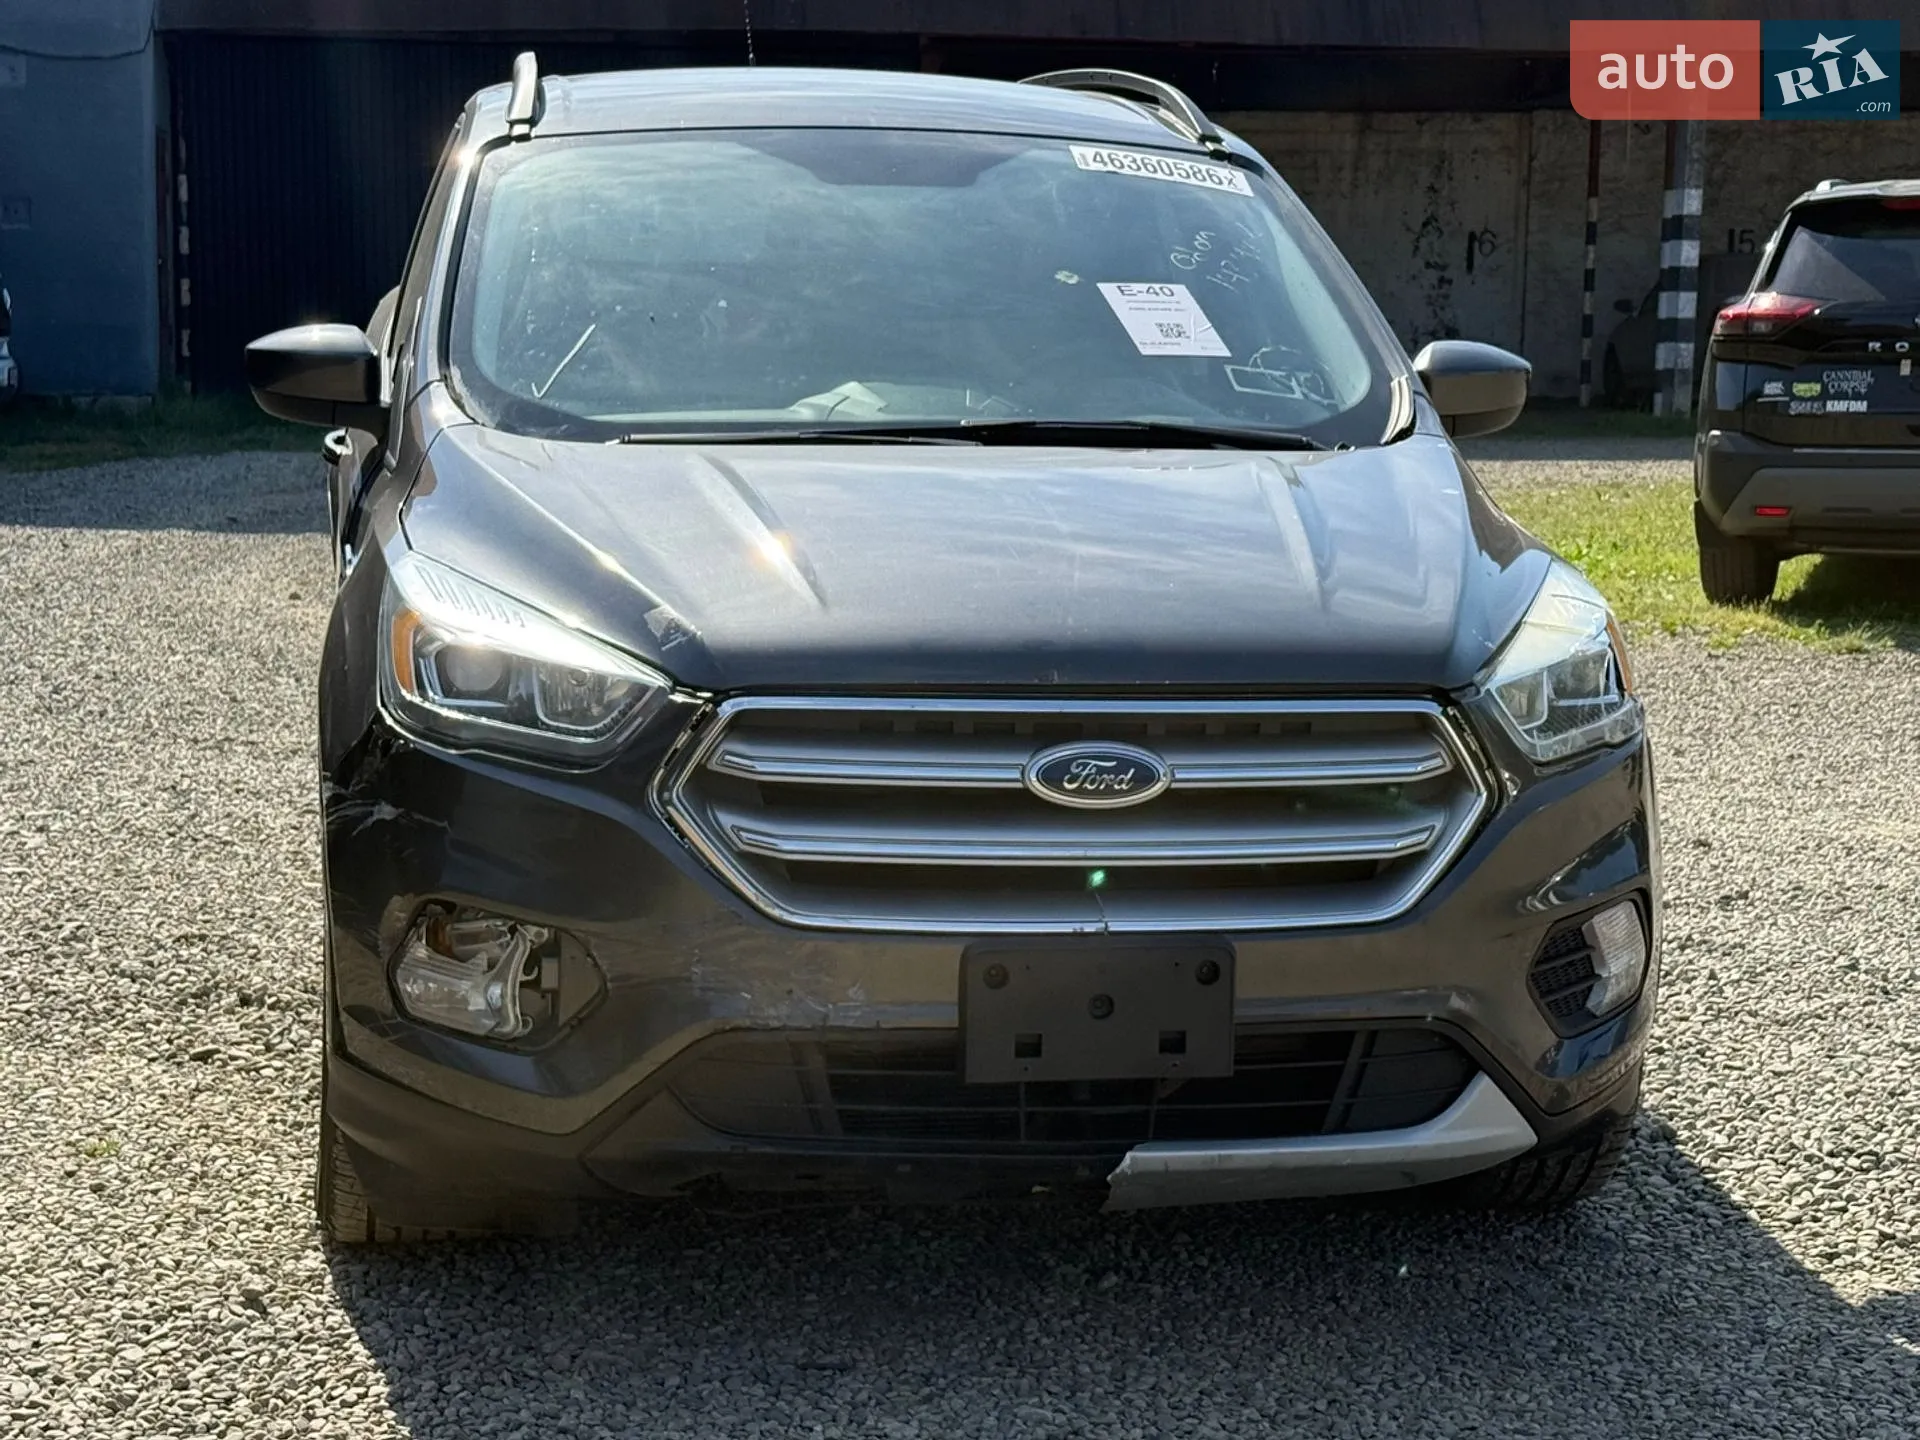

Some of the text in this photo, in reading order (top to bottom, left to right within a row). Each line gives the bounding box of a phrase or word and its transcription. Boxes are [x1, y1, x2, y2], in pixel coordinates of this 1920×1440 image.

[1728, 228, 1755, 254] 15
[1116, 285, 1175, 297] E-40
[1826, 400, 1868, 412] KMFDM
[1062, 758, 1136, 790] Ford
